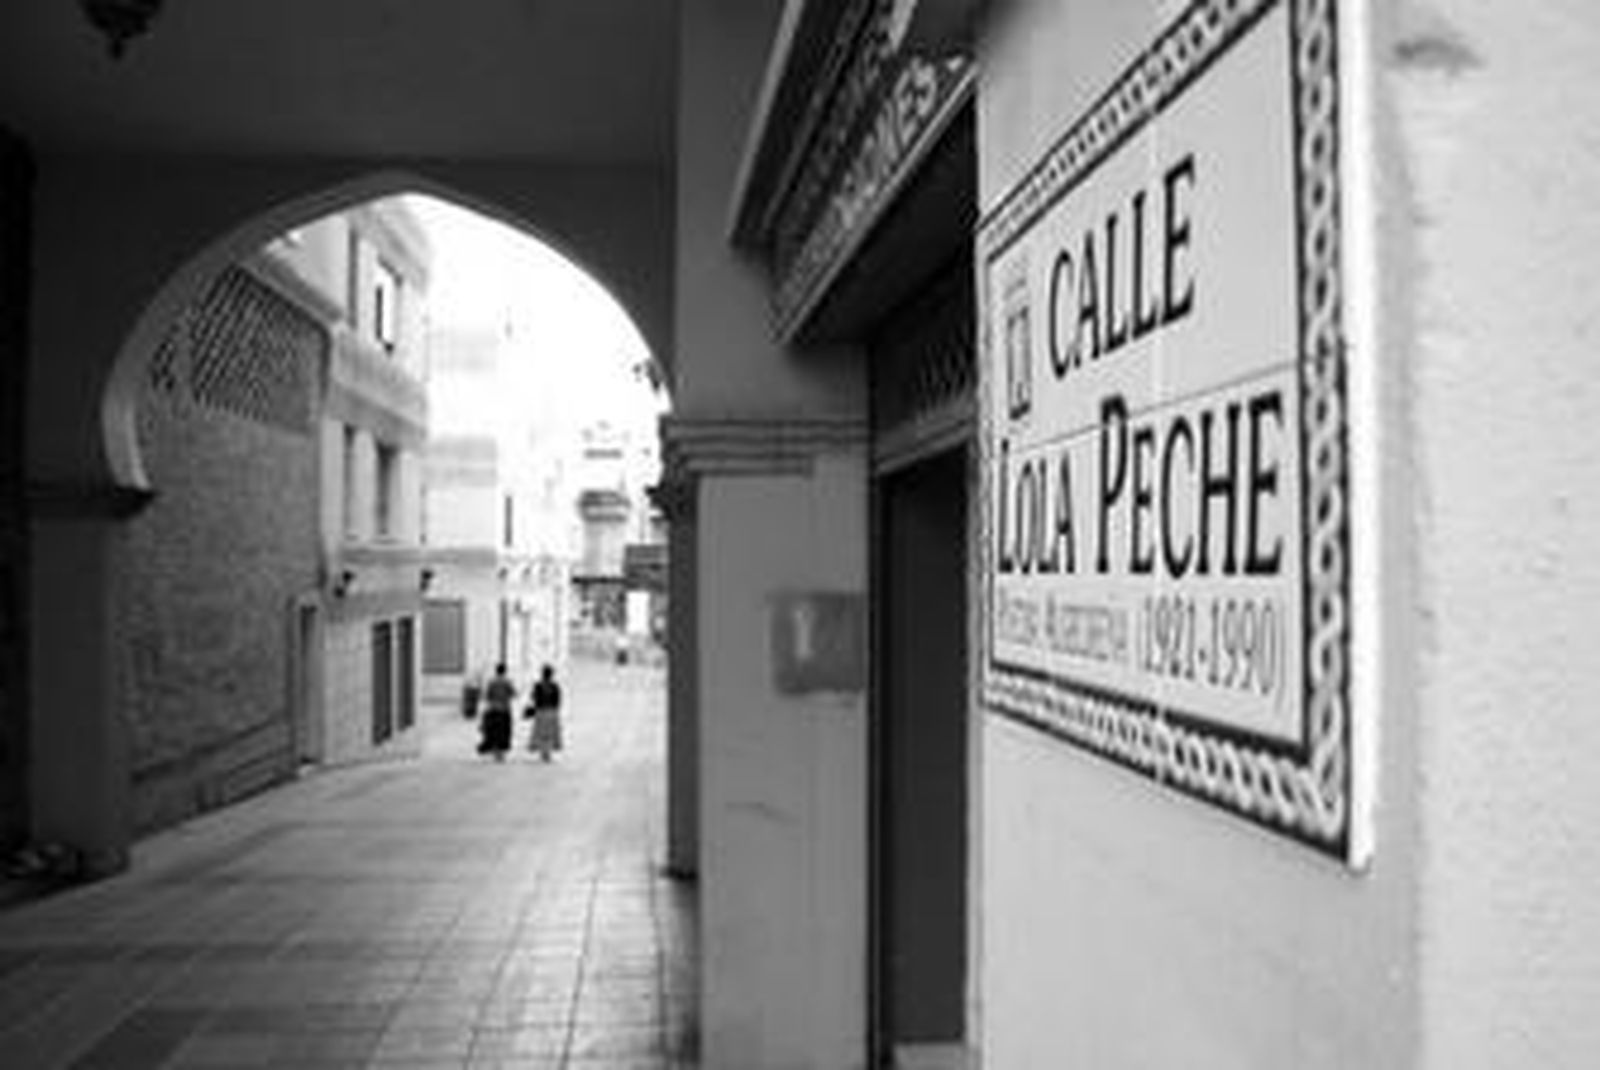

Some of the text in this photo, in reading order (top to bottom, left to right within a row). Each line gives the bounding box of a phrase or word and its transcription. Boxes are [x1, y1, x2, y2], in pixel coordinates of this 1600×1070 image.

[1049, 152, 1195, 380] CALLE
[997, 392, 1283, 580] LOLA PECHE
